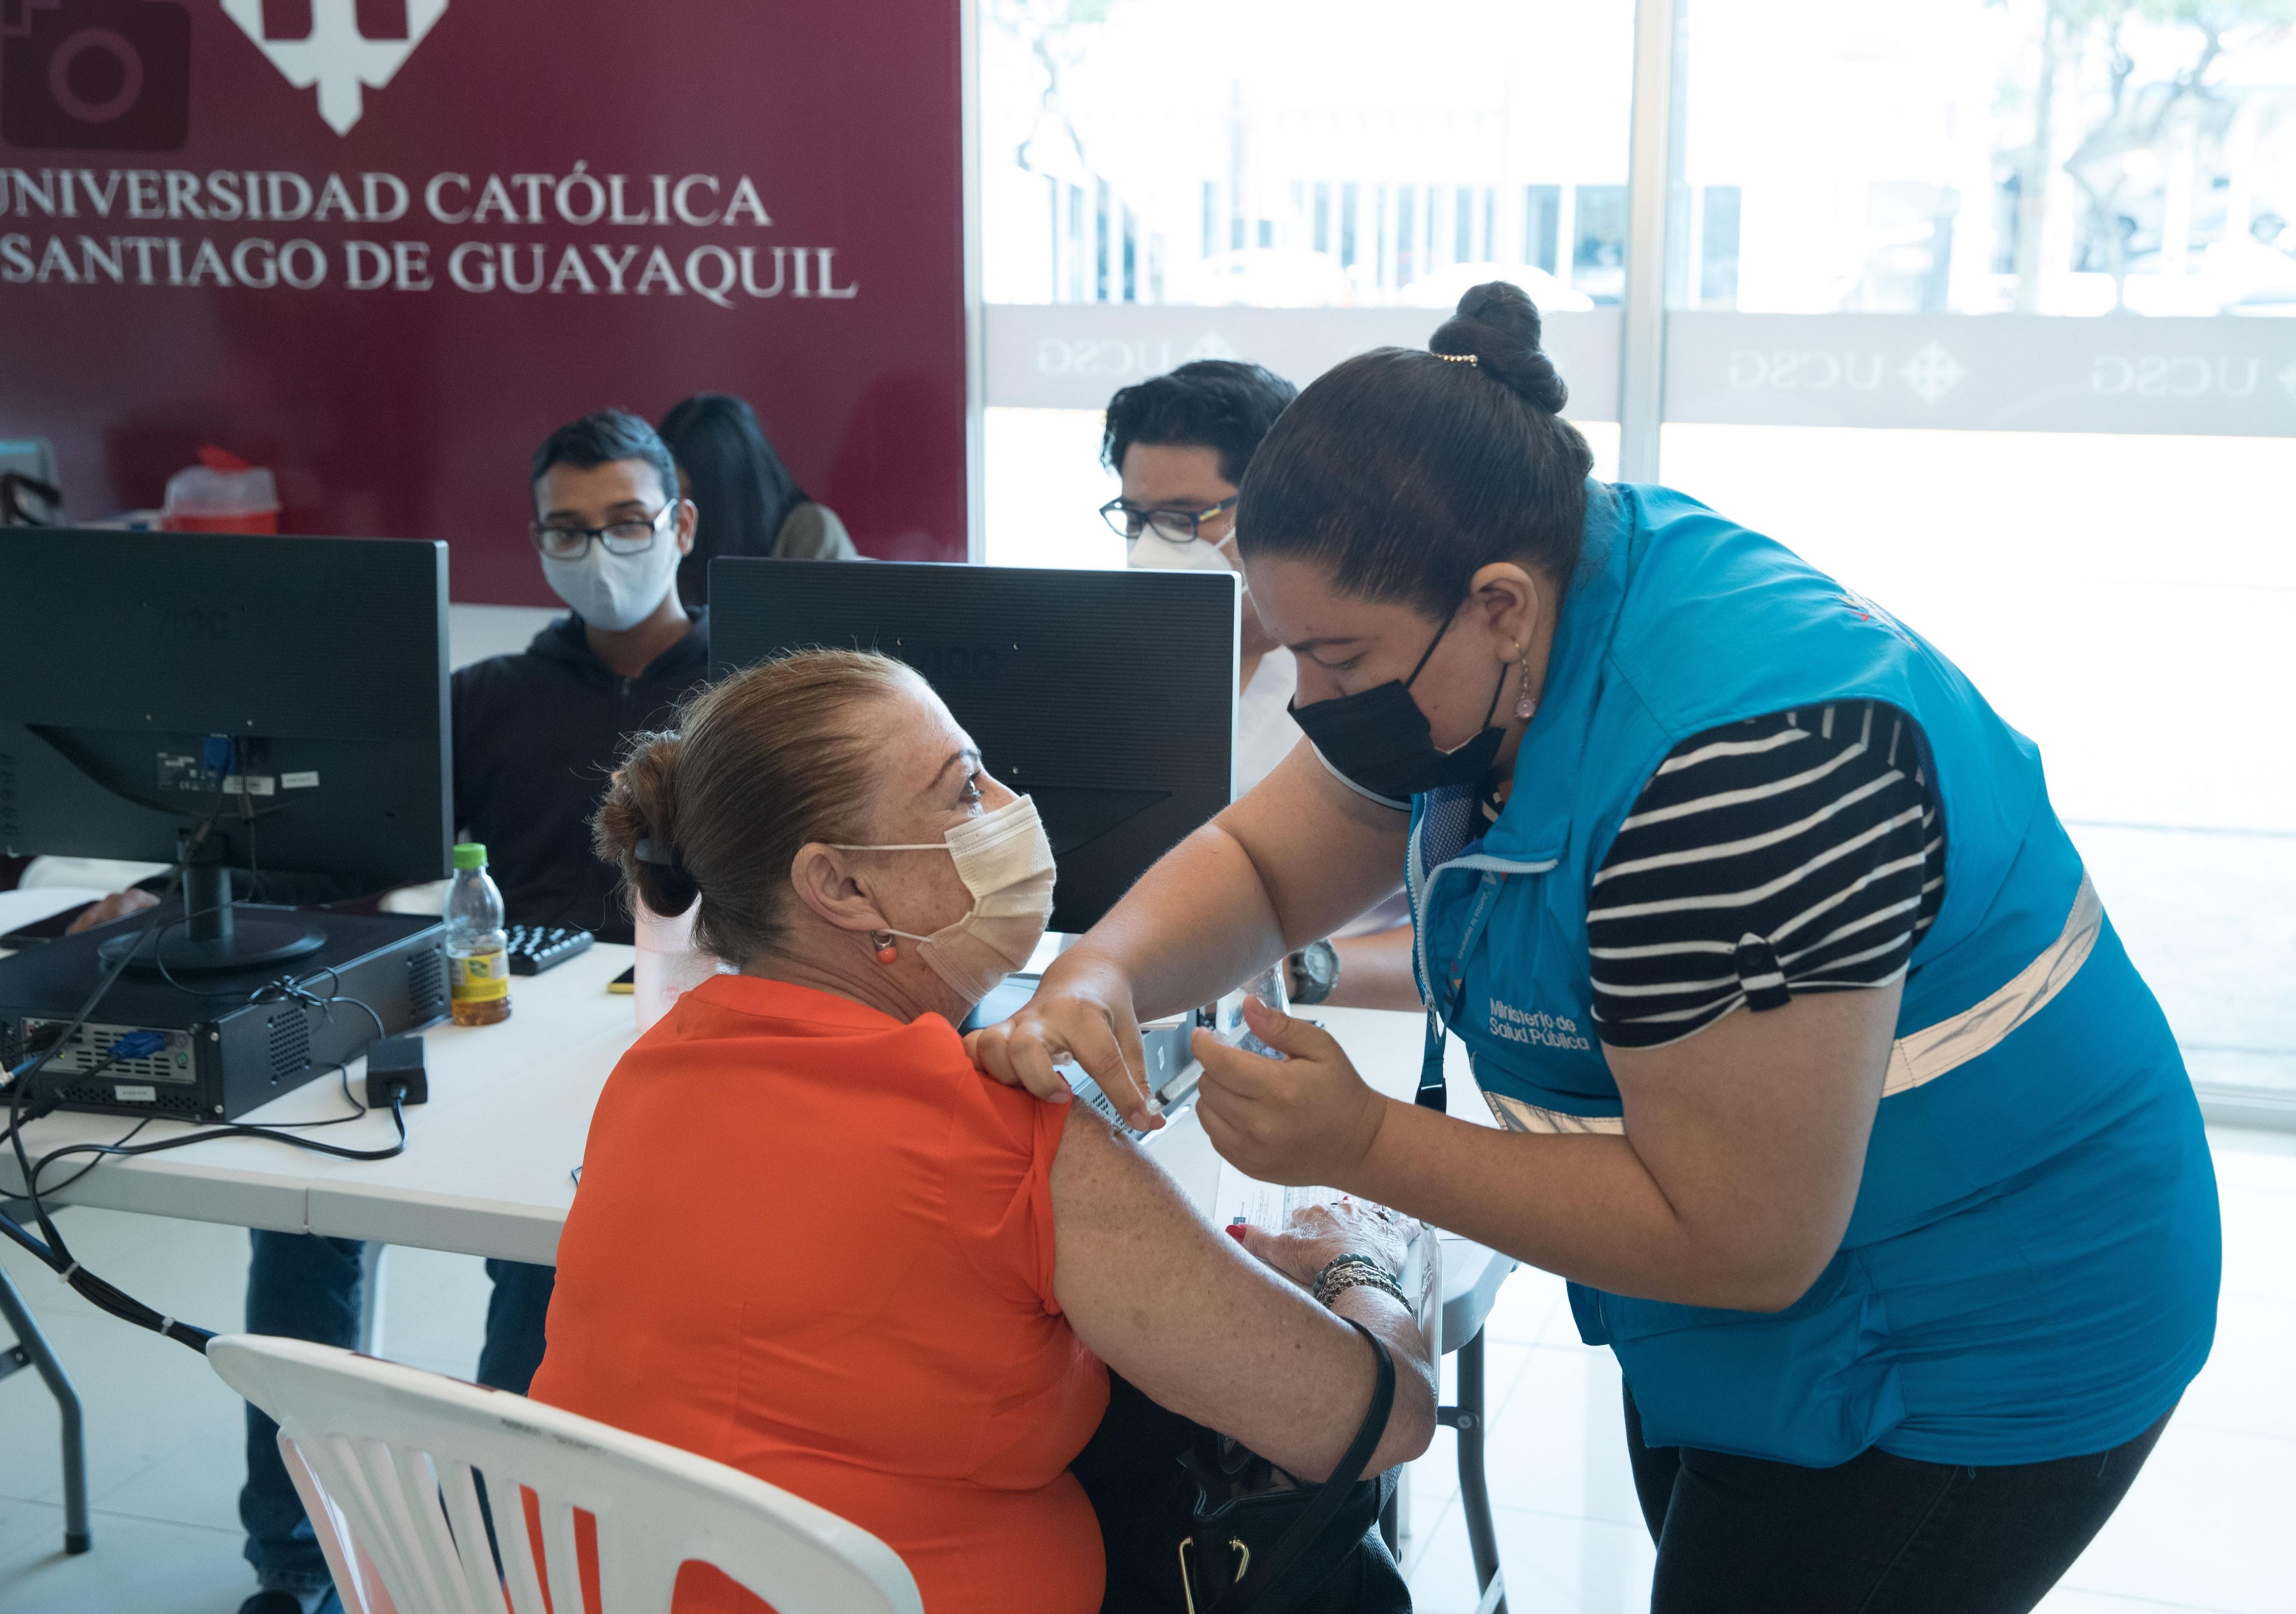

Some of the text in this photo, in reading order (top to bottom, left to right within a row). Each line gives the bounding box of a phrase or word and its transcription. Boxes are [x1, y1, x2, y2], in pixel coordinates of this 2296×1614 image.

[0, 159, 775, 227] NIVERSIDAD CATÓLICA
[0, 233, 860, 309] SANTIAGO DE GUAYAQUIL
[1490, 997, 1577, 1033] Ministerio de
[1490, 1017, 1591, 1051] Salud Pública
